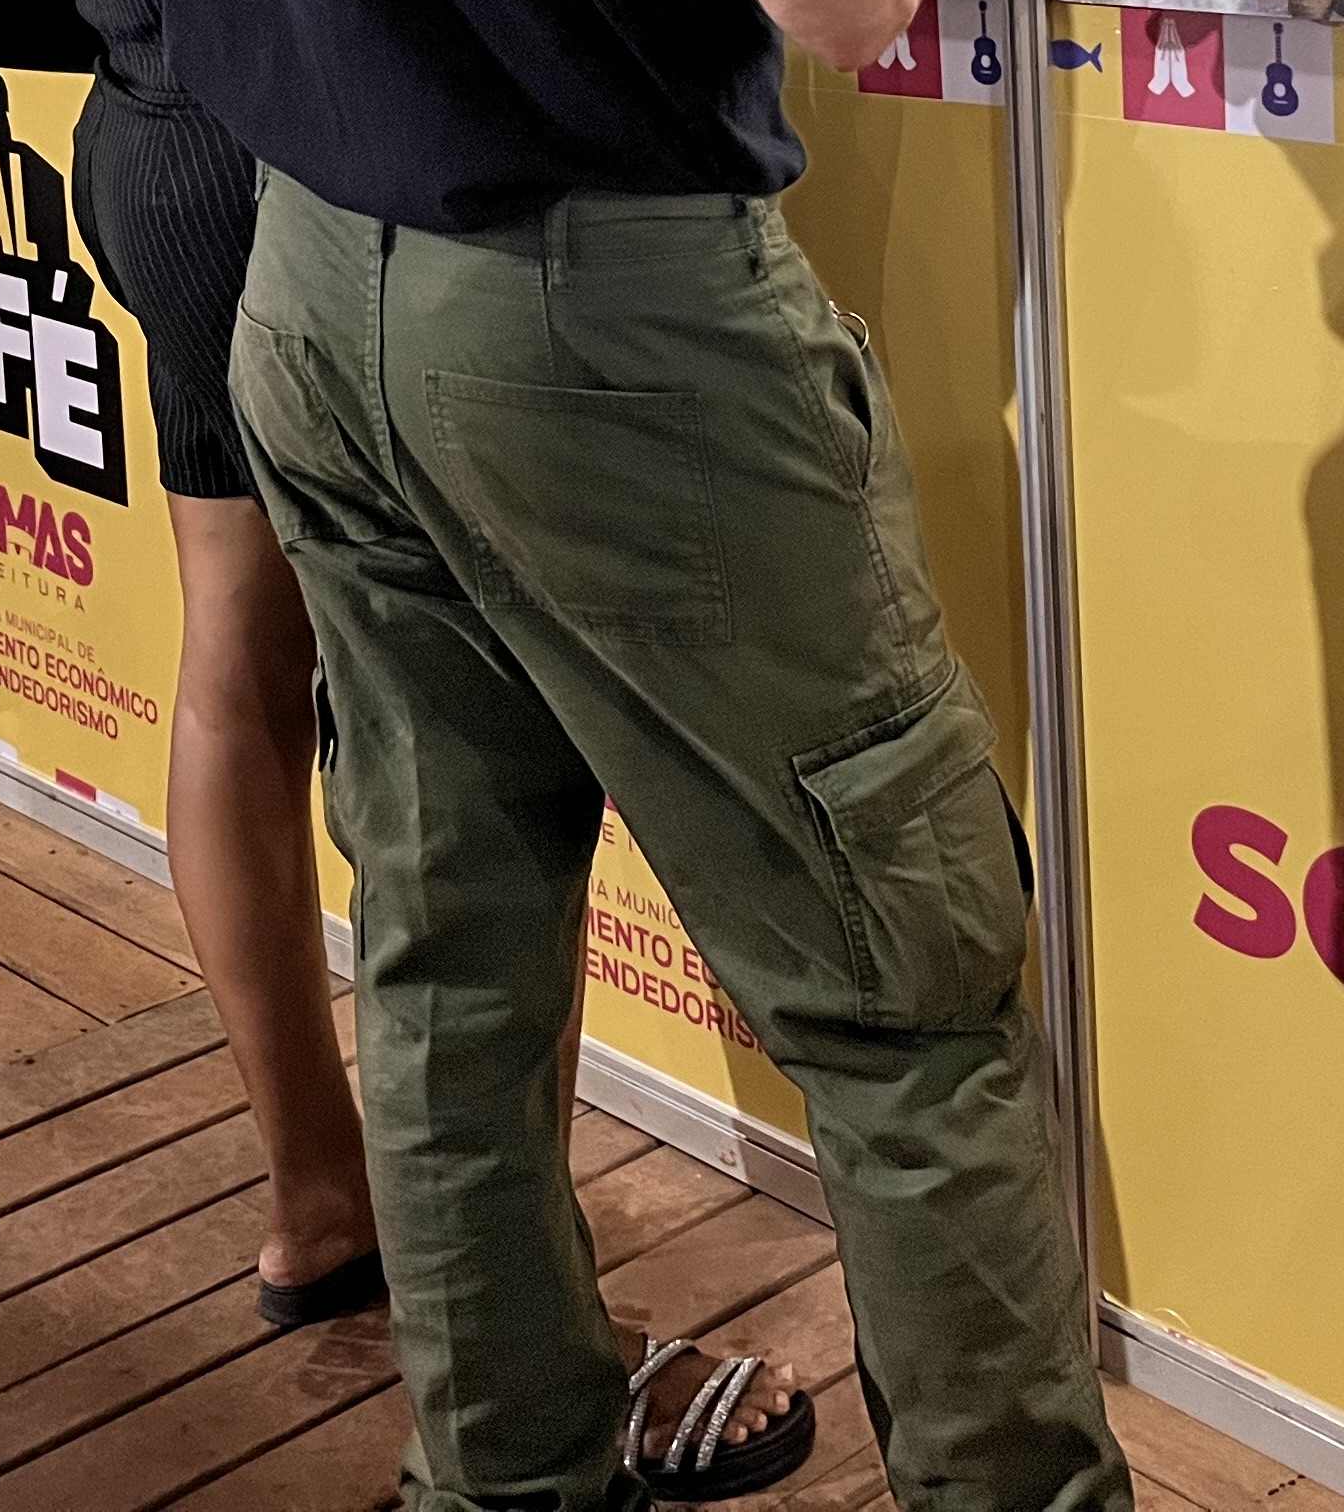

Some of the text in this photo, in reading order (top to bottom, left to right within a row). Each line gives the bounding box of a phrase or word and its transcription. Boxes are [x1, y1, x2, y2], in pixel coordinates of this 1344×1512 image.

[5, 609, 73, 654] MUNICIPAL
[77, 640, 96, 664] DE
[45, 651, 158, 725] ECONÔMICO
[616, 886, 681, 930] MUNIC
[586, 946, 762, 1053] ENDEDORIS
